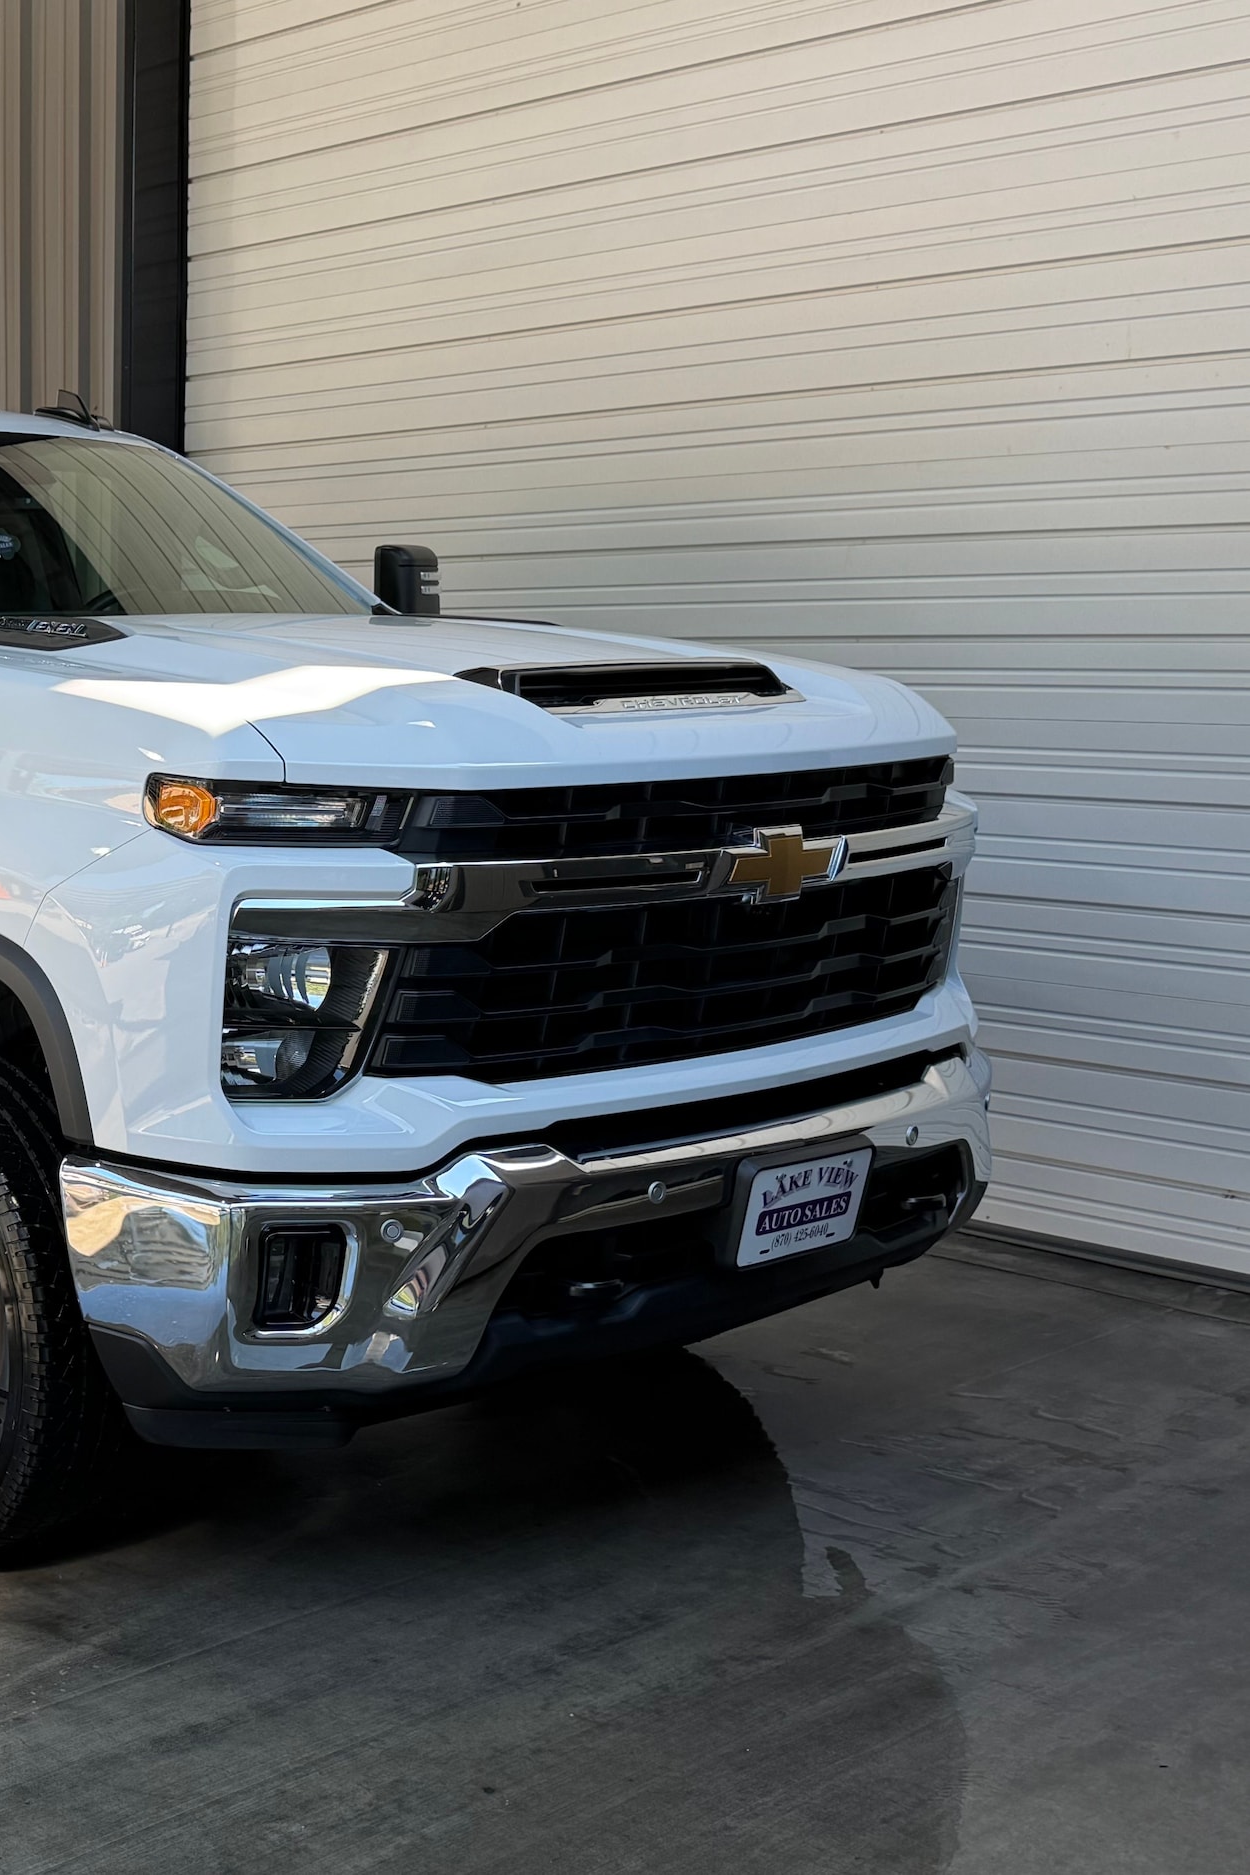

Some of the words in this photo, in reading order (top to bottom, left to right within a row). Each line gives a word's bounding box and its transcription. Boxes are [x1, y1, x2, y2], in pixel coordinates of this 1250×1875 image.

[620, 694, 742, 710] CHEVROLET
[761, 1168, 813, 1208] LAKE
[817, 1166, 859, 1190] VIEW
[759, 1207, 801, 1233] AUTO
[803, 1195, 849, 1222] SALES
[770, 1227, 792, 1251] (870)
[793, 1222, 829, 1243] 425-6040
